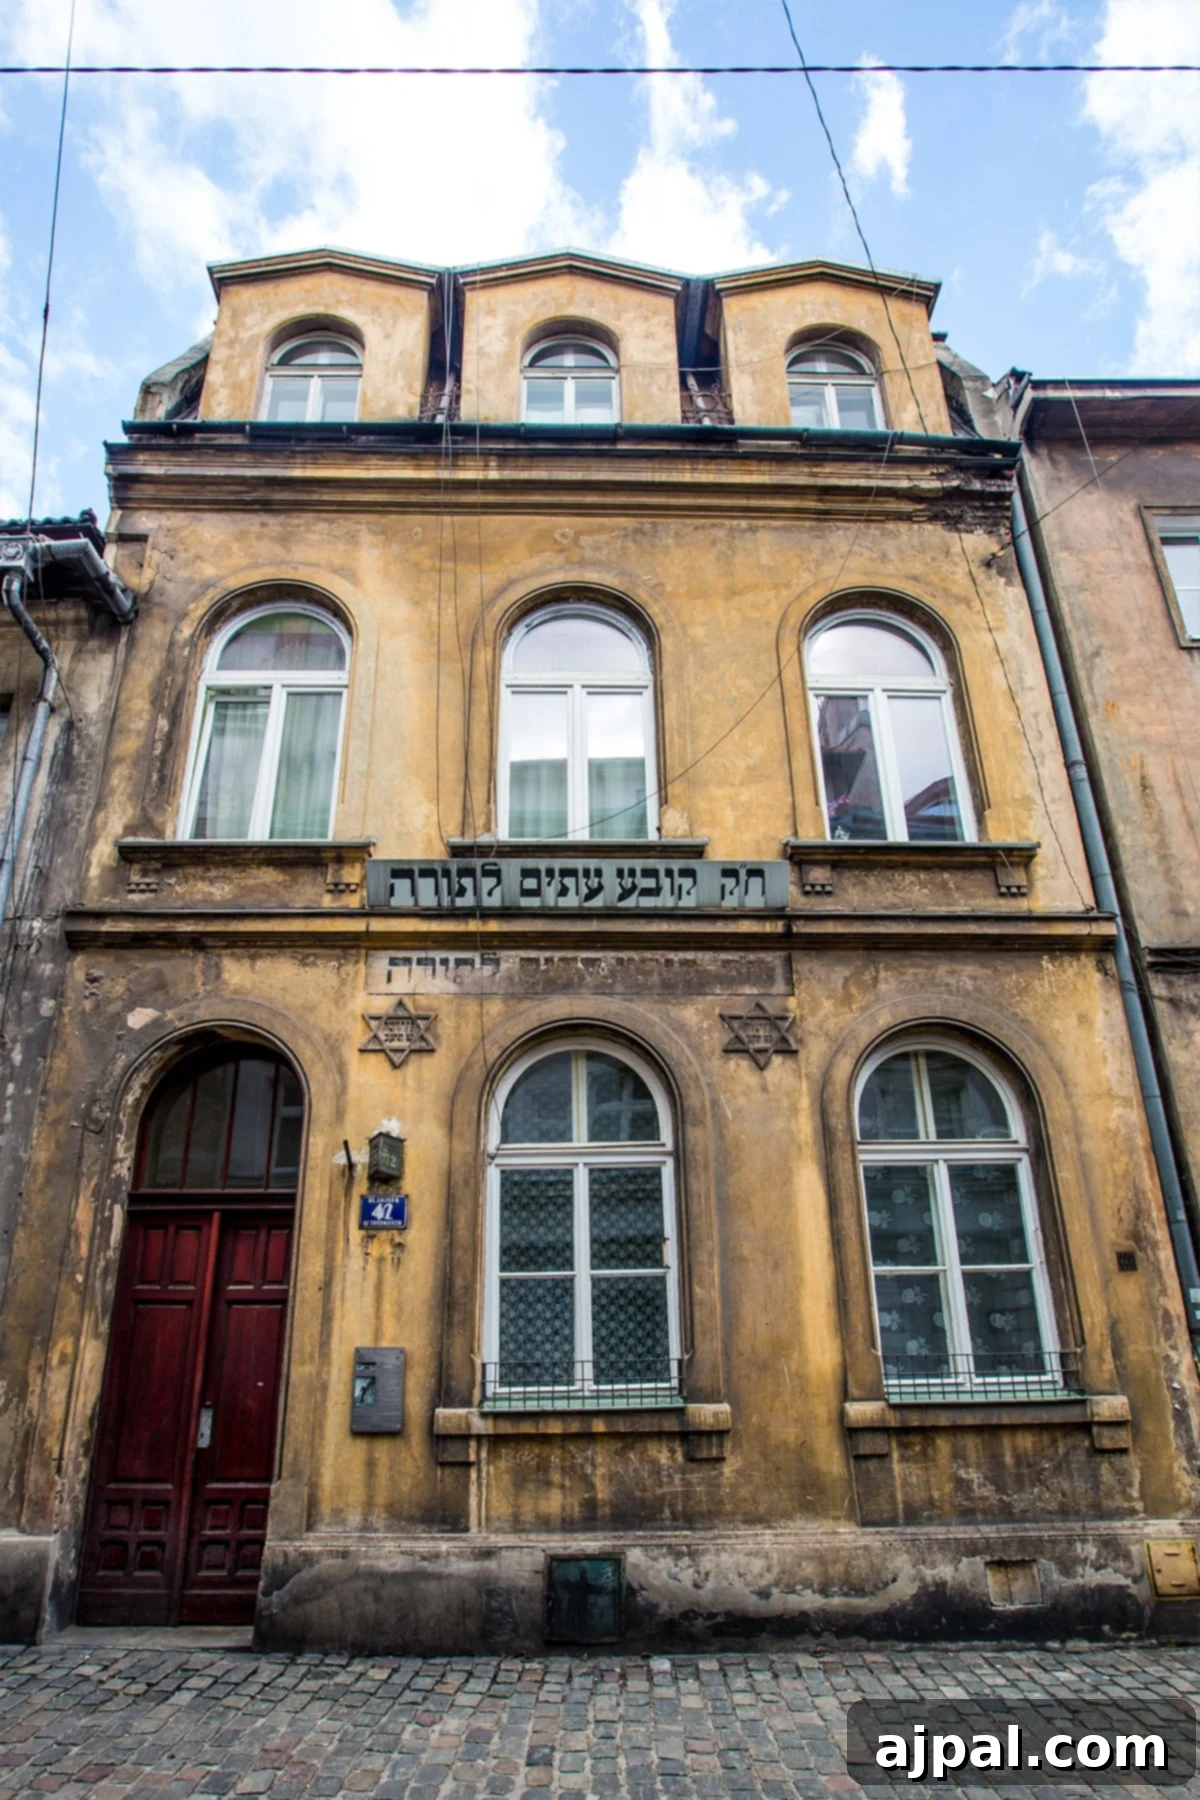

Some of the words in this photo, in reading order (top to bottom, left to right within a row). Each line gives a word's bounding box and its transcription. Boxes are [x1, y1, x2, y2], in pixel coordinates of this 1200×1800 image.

[389, 862, 501, 898] לתורה
[520, 867, 604, 903] עתים
[616, 867, 697, 903] קובע
